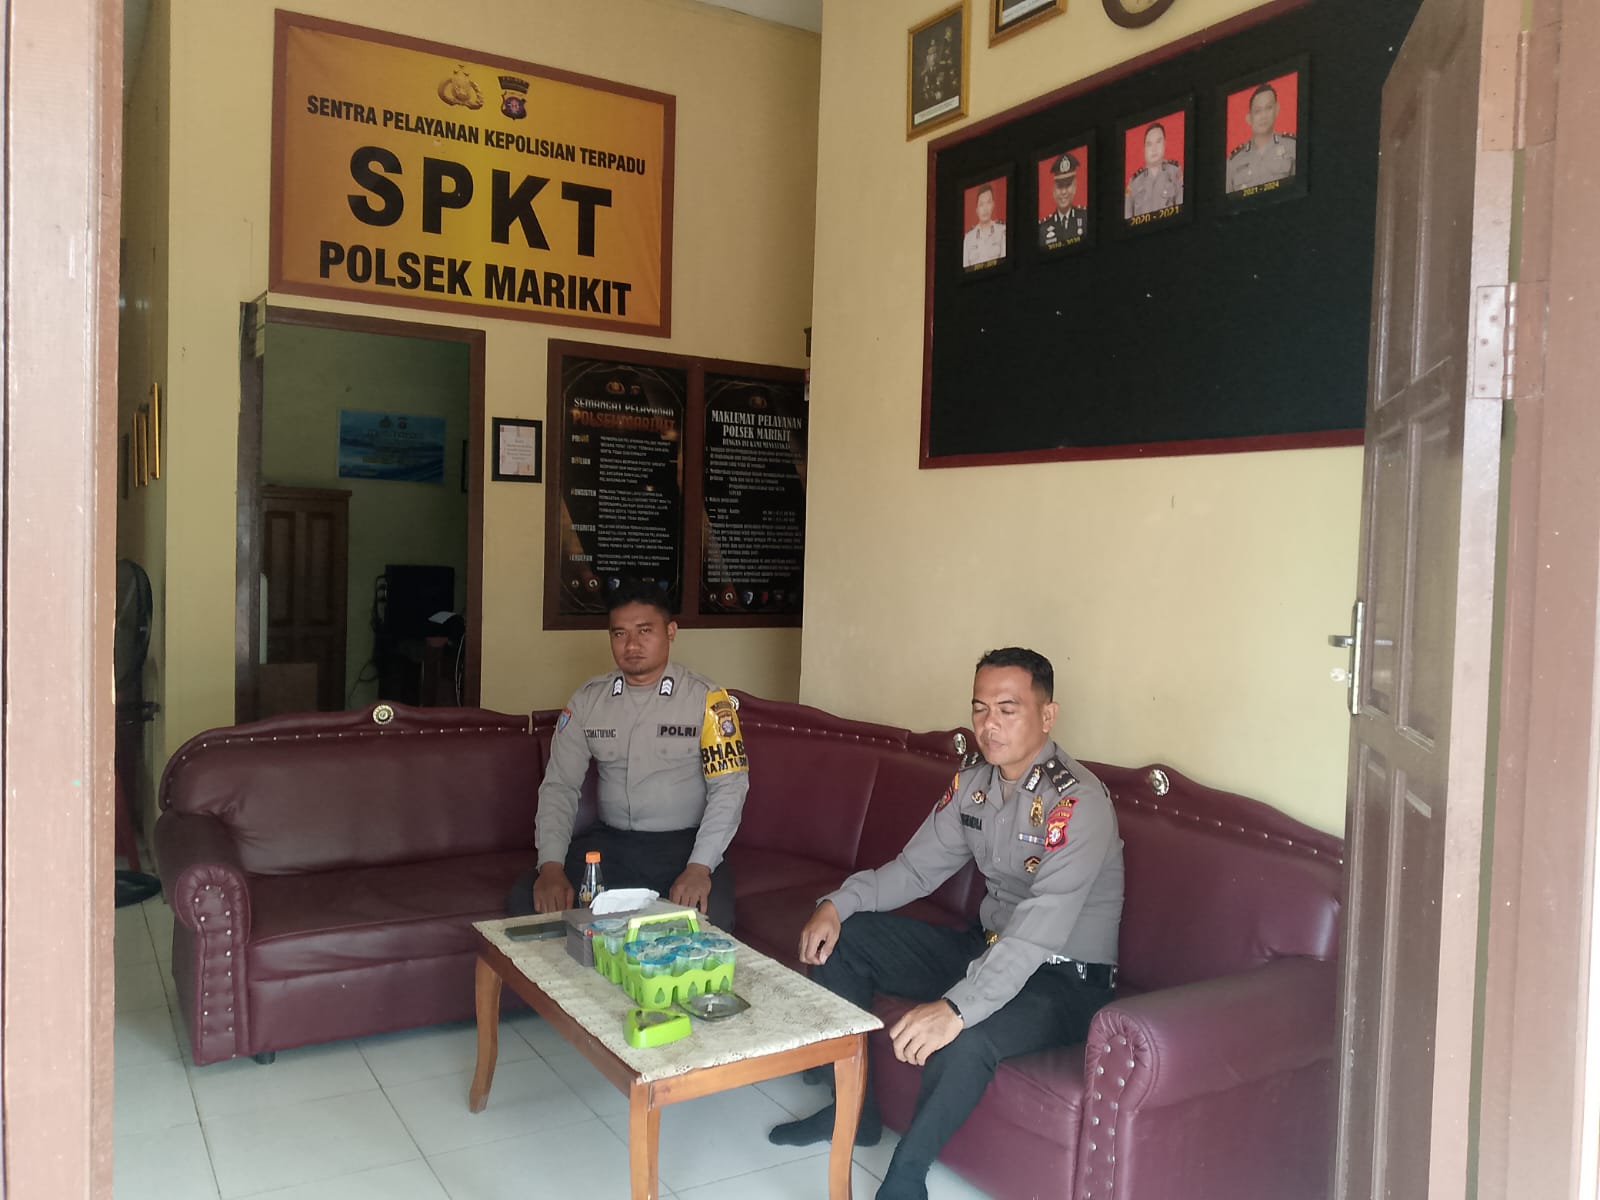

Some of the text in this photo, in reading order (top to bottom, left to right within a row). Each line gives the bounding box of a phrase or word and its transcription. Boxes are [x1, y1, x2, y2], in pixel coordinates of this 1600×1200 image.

[306, 95, 646, 175] SENTRA PELAYANAN KEPOLISIAN TERPADU
[347, 145, 612, 257] SPKT
[319, 240, 632, 316] POLSEK MARIKIT
[711, 409, 803, 430] MAKLUMAT PELAYANAN
[722, 424, 791, 442] POLSEK MARIKIT
[660, 725, 697, 737] POLRI
